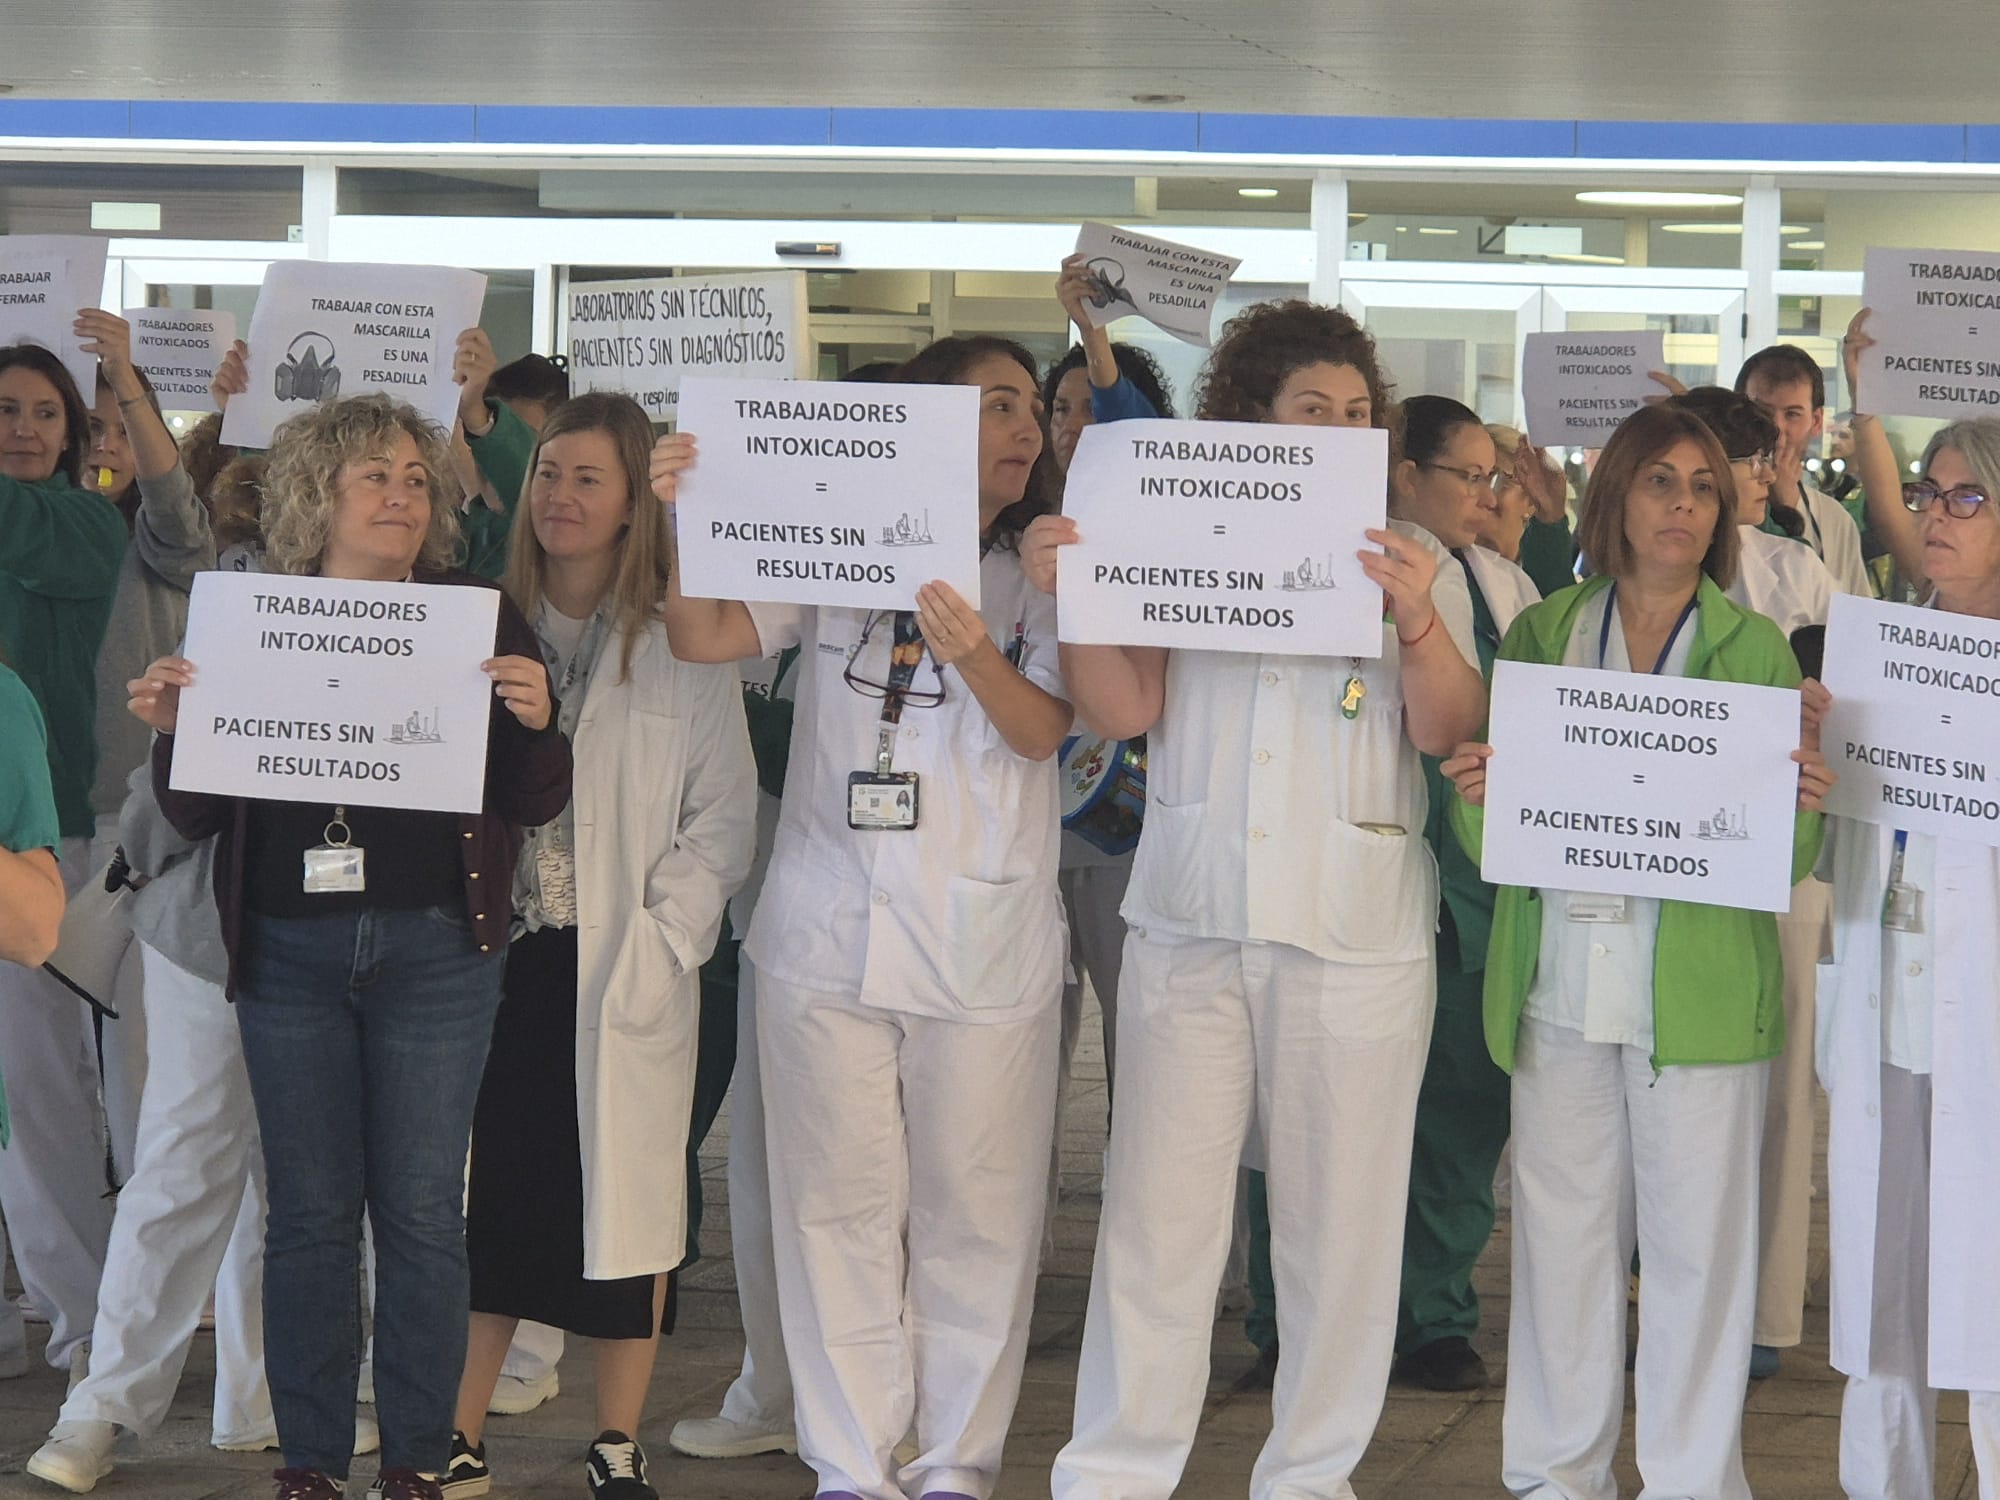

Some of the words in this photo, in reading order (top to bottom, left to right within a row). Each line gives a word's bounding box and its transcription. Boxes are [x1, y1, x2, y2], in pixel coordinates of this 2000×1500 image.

[1110, 234, 1170, 257] TRABAJAR
[1171, 250, 1199, 263] CON
[1200, 258, 1231, 271] ESTA
[1147, 258, 1223, 281] MASCARILLA
[1169, 278, 1184, 287] ES
[1187, 281, 1214, 293] UNA
[311, 298, 373, 314] TRABAJAR
[374, 302, 402, 316] CON
[404, 304, 434, 319] ESTA
[568, 290, 656, 322] LABORATORIOS
[659, 289, 686, 320] SIN
[690, 283, 773, 326] TÉCNICOS,
[1149, 292, 1207, 309] PESADILLA
[138, 319, 215, 333] TRABAJADORES
[353, 323, 431, 340] MASCARILLA
[138, 335, 210, 349] INTOXICADOS
[572, 336, 644, 367] PACIENTES
[647, 337, 673, 367] SIN
[681, 326, 785, 366] DIAGNÓSTICOS
[1555, 344, 1637, 357] TRABAJADORES
[383, 348, 398, 362] ES
[400, 349, 429, 364] UNA
[1884, 355, 1973, 376] PACIENTES
[1976, 361, 2000, 378] SIN
[194, 367, 213, 379] SIN
[362, 369, 428, 386] PESADILLA
[1558, 364, 1633, 376] INTOXICADOS
[642, 387, 680, 415] respira
[734, 399, 907, 424] TRABAJADORES
[1558, 398, 1617, 410] PACIENTES
[1619, 398, 1639, 409] SIN
[746, 435, 897, 460] INTOXICADOS
[1131, 439, 1314, 466] TRABAJADORES
[1140, 476, 1302, 502] INTOXICADOS
[711, 521, 824, 545] PACIENTES
[830, 526, 865, 547] SIN
[756, 558, 896, 584] RESULTADOS
[1094, 564, 1219, 589] PACIENTES
[1226, 570, 1264, 591] SIN
[253, 594, 427, 622] TRABAJADORES
[1143, 602, 1294, 628] RESULTADOS
[260, 630, 414, 657] INTOXICADOS
[1555, 687, 1730, 721] TRABAJADORES
[213, 716, 332, 742] PACIENTES
[337, 723, 374, 744] SIN
[1564, 724, 1718, 756] INTOXICADOS
[257, 754, 401, 782] RESULTADOS
[1845, 741, 1947, 776] PACIENTES
[1952, 760, 1986, 783] SIN
[1881, 783, 2000, 821] RESULTADO
[1520, 807, 1638, 836] PACIENTES
[1644, 818, 1681, 840] SIN
[1565, 846, 1709, 878] RESULTADOS
